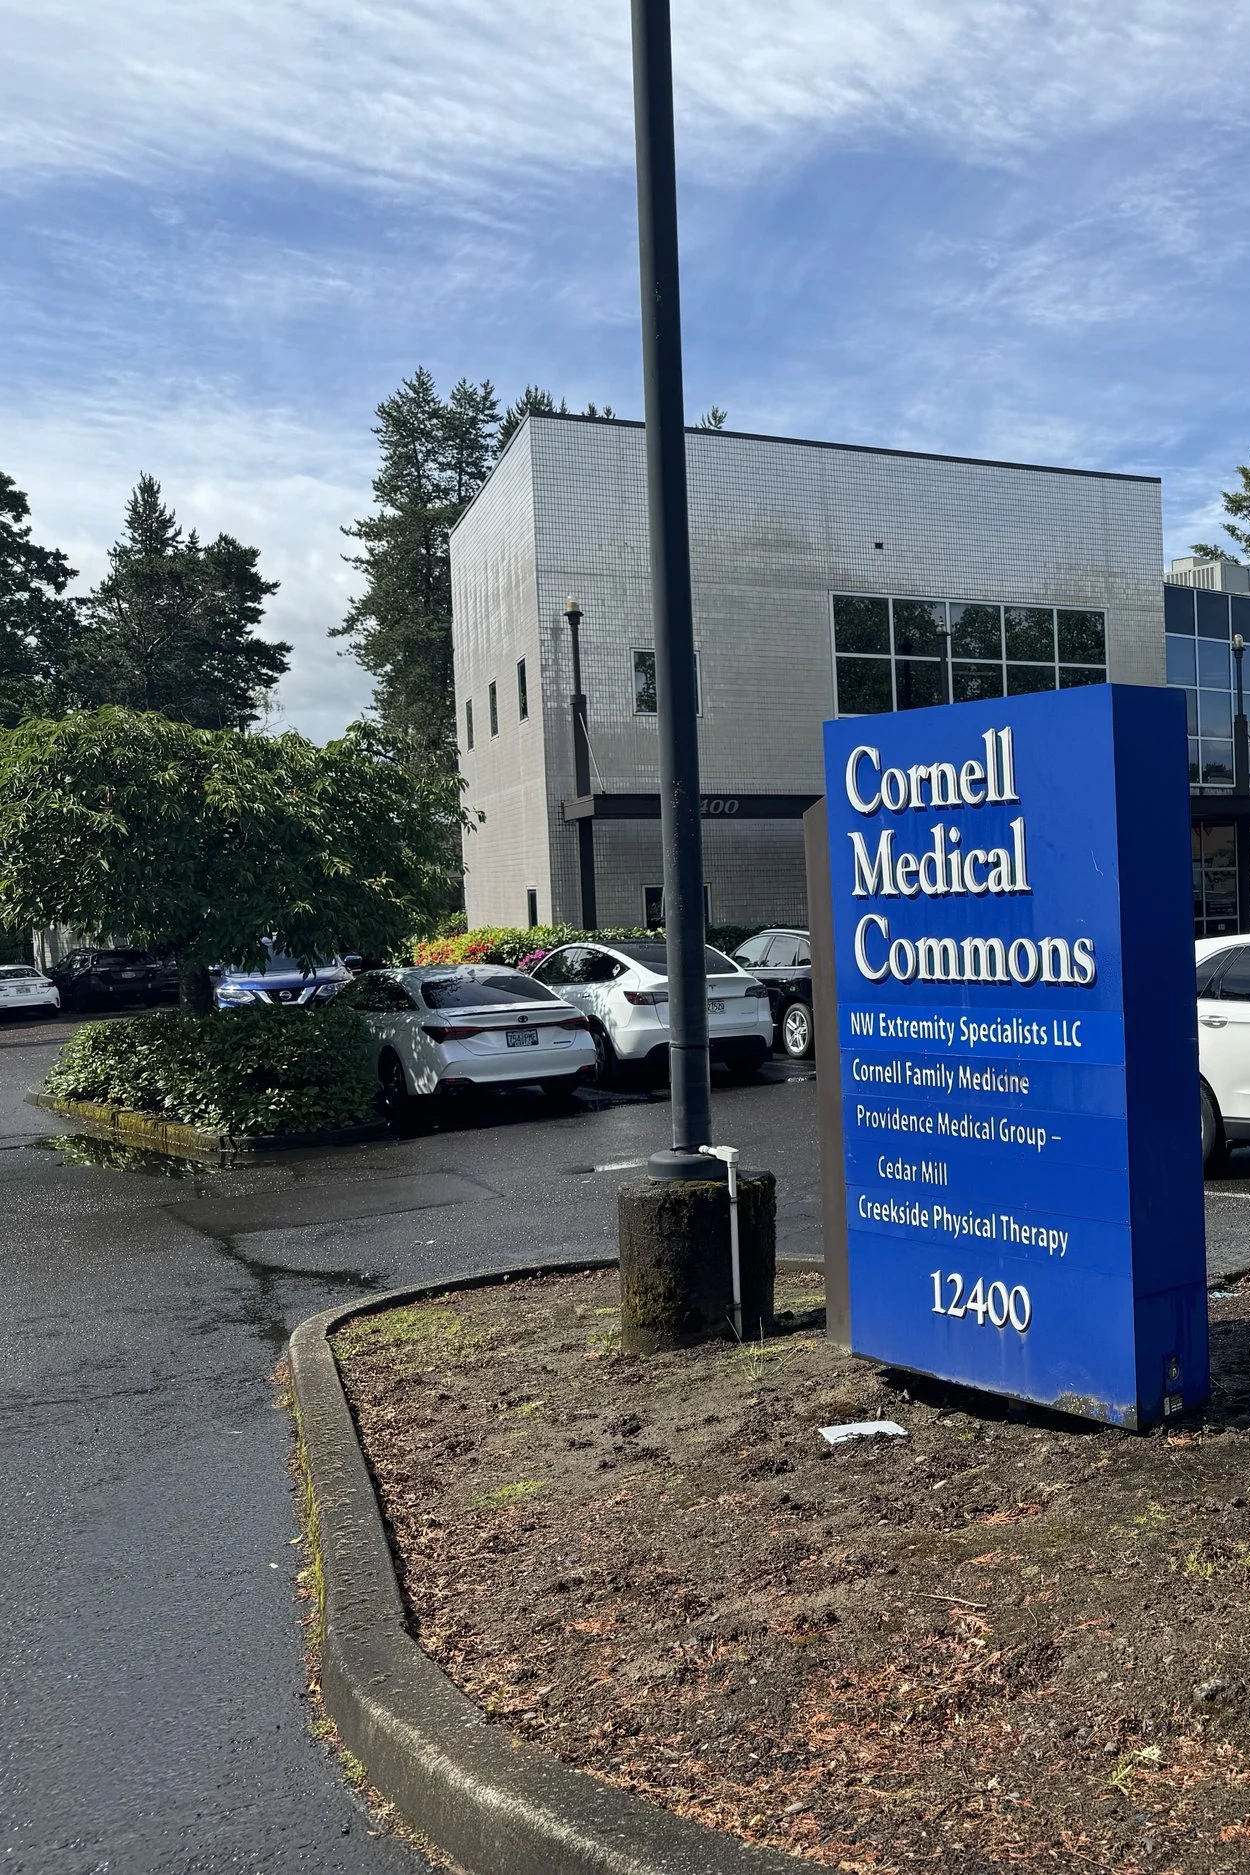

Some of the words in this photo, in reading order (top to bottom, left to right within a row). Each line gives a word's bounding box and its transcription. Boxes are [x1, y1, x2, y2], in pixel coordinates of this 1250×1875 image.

[845, 725, 1020, 814] Cornell
[847, 816, 1032, 896] Medical
[854, 913, 1096, 984] Commons
[850, 1011, 874, 1036] NW
[879, 1012, 955, 1047] Extremity
[959, 1016, 1048, 1048] Specialists
[1053, 1019, 1082, 1047] LLC
[852, 1058, 902, 1084] Cornell
[905, 1061, 954, 1094] Family
[958, 1065, 1030, 1095] Medicine
[857, 1104, 933, 1134] Providence
[937, 1111, 995, 1140] Medical
[999, 1118, 1047, 1153] Group
[878, 1155, 917, 1182] Cedar
[921, 1160, 948, 1186] Mill
[858, 1194, 929, 1228] Creekside
[933, 1204, 996, 1239] Physical
[999, 1215, 1069, 1257] Therapy
[929, 1269, 1031, 1333] 12400
